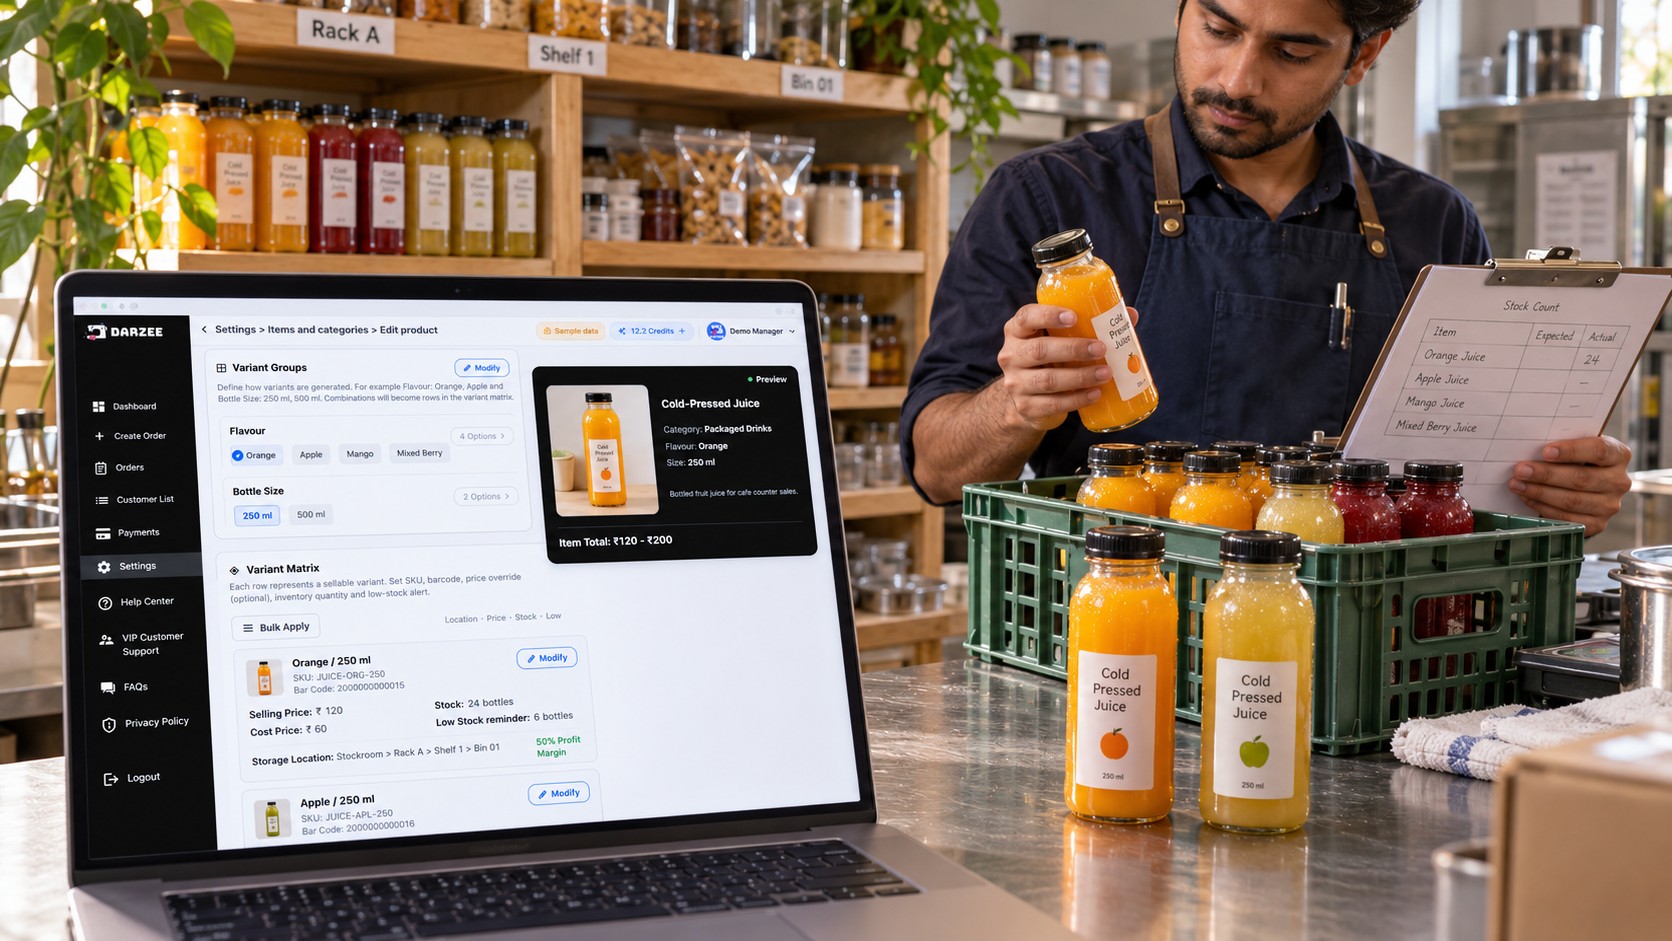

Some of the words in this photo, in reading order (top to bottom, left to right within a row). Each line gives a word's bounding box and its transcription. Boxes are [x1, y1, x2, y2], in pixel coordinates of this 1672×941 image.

[312, 19, 359, 42] Rack
[365, 25, 380, 44] A
[540, 45, 582, 64] Shelf
[587, 50, 593, 65] 1
[817, 76, 833, 94] 01
[1503, 300, 1529, 311] Stock
[1532, 301, 1560, 312] Count
[110, 327, 163, 337] DARZEE
[215, 324, 257, 336] Settings
[267, 325, 296, 334] Items
[297, 325, 316, 334] and
[317, 325, 369, 336] categories
[380, 325, 399, 334] Edit
[400, 326, 438, 336] product
[631, 327, 647, 335] 12.2
[648, 327, 675, 335] Credits
[729, 327, 752, 335] Demo
[752, 327, 784, 337] Manager
[1433, 325, 1457, 337] Item
[1535, 330, 1576, 343] Expected
[1588, 331, 1617, 342] Actual
[1424, 348, 1459, 365] Orange
[1460, 351, 1486, 362] Juice
[1583, 354, 1600, 366] 24
[232, 363, 269, 372] Variant
[270, 363, 308, 374] Groups
[474, 364, 501, 374] Modify
[756, 375, 788, 383] Preview
[1414, 372, 1442, 386] Apple
[1444, 373, 1470, 385] Juice
[217, 383, 243, 392] Define
[245, 383, 262, 391] how
[263, 383, 295, 391] variants
[310, 383, 353, 393] generated.
[354, 382, 368, 391] For
[368, 383, 401, 392] example
[402, 382, 433, 390] Flavour:
[434, 382, 465, 392] Orange,
[466, 382, 488, 391] Apple
[489, 382, 504, 390] and
[113, 402, 157, 411] Dashboard
[661, 398, 731, 409] Cold-Pressed
[733, 398, 760, 408] Juice
[1405, 396, 1437, 412] Mango
[1440, 397, 1465, 408] Juice
[229, 426, 266, 436] Flavour
[663, 425, 703, 435] Category:
[704, 425, 745, 435] Packaged
[746, 424, 773, 433] Drinks
[1395, 419, 1425, 431] Mixed
[1426, 420, 1452, 435] Berry
[1453, 422, 1477, 433] Juice
[114, 432, 142, 440] Create
[143, 432, 167, 440] Order
[246, 451, 276, 461] Orange
[299, 450, 323, 460] Apple
[346, 450, 374, 459] Mango
[397, 449, 421, 457] Mixed
[422, 449, 443, 458] Berry
[115, 463, 145, 472] Orders
[232, 487, 262, 496] Bottle
[263, 486, 284, 496] Size
[116, 495, 158, 504] Customer
[159, 495, 175, 503] List
[242, 511, 260, 520] 250
[262, 511, 273, 519] ml
[118, 528, 160, 539] Payments
[559, 538, 582, 548] Item
[583, 537, 611, 547] Total:
[119, 561, 157, 572] Settings
[246, 564, 284, 575] Variant
[286, 563, 320, 573] Matrix
[229, 582, 250, 591] Each
[269, 581, 314, 591] represents
[322, 579, 355, 588] sellable
[356, 578, 387, 587] variant.
[388, 577, 403, 585] Set
[405, 576, 426, 585] SKU,
[427, 575, 464, 584] barcode,
[465, 574, 487, 584] price
[488, 573, 522, 582] override
[120, 597, 142, 607] Help
[143, 597, 175, 606] Center
[260, 623, 281, 632] Bulk
[282, 622, 310, 633] Apply
[121, 633, 138, 642] VIP
[139, 633, 184, 642] Customer
[122, 646, 160, 657] Support
[292, 658, 329, 669] Orange
[337, 656, 357, 666] 250
[359, 655, 371, 665] ml
[539, 653, 568, 663] Modify
[293, 673, 314, 682] SKU:
[316, 669, 386, 681] JUICE-ORG-250
[1101, 667, 1130, 680] Cold
[1241, 674, 1271, 688] Cold
[124, 682, 148, 692] FAQs
[293, 686, 308, 694] Bar
[310, 685, 335, 694] Code:
[1093, 683, 1141, 697] Pressed
[1232, 690, 1282, 704] Pressed
[434, 700, 464, 710] Stock:
[468, 699, 480, 708] 24
[482, 697, 514, 707] bottles
[1094, 699, 1127, 713] Juice
[249, 709, 282, 720] Selling
[284, 708, 312, 717] Price:
[326, 706, 343, 715] 120
[1233, 706, 1268, 721] Juice
[125, 718, 160, 728] Privacy
[161, 716, 190, 727] Policy
[436, 718, 455, 727] Low
[457, 716, 484, 726] Stock
[486, 714, 530, 724] reminder:
[533, 712, 540, 721] 6
[542, 712, 574, 721] bottles
[536, 737, 556, 746] 50%
[557, 735, 581, 745] Profit
[251, 757, 289, 767] Storage
[291, 753, 334, 764] Location:
[336, 751, 384, 761] Stockroom
[393, 748, 415, 757] Rack
[417, 748, 424, 756] A
[434, 745, 456, 755] Shelf
[459, 745, 463, 753] 1
[489, 743, 500, 751] 01
[537, 748, 567, 758] Margin
[127, 772, 161, 784] Logout
[1102, 772, 1115, 780] 250
[1115, 773, 1125, 781] ml
[1241, 781, 1255, 789] 250
[1255, 782, 1265, 790] ml
[551, 788, 580, 798] Modify
[300, 797, 331, 810] Apple
[339, 795, 360, 806] 250
[362, 794, 375, 804] ml
